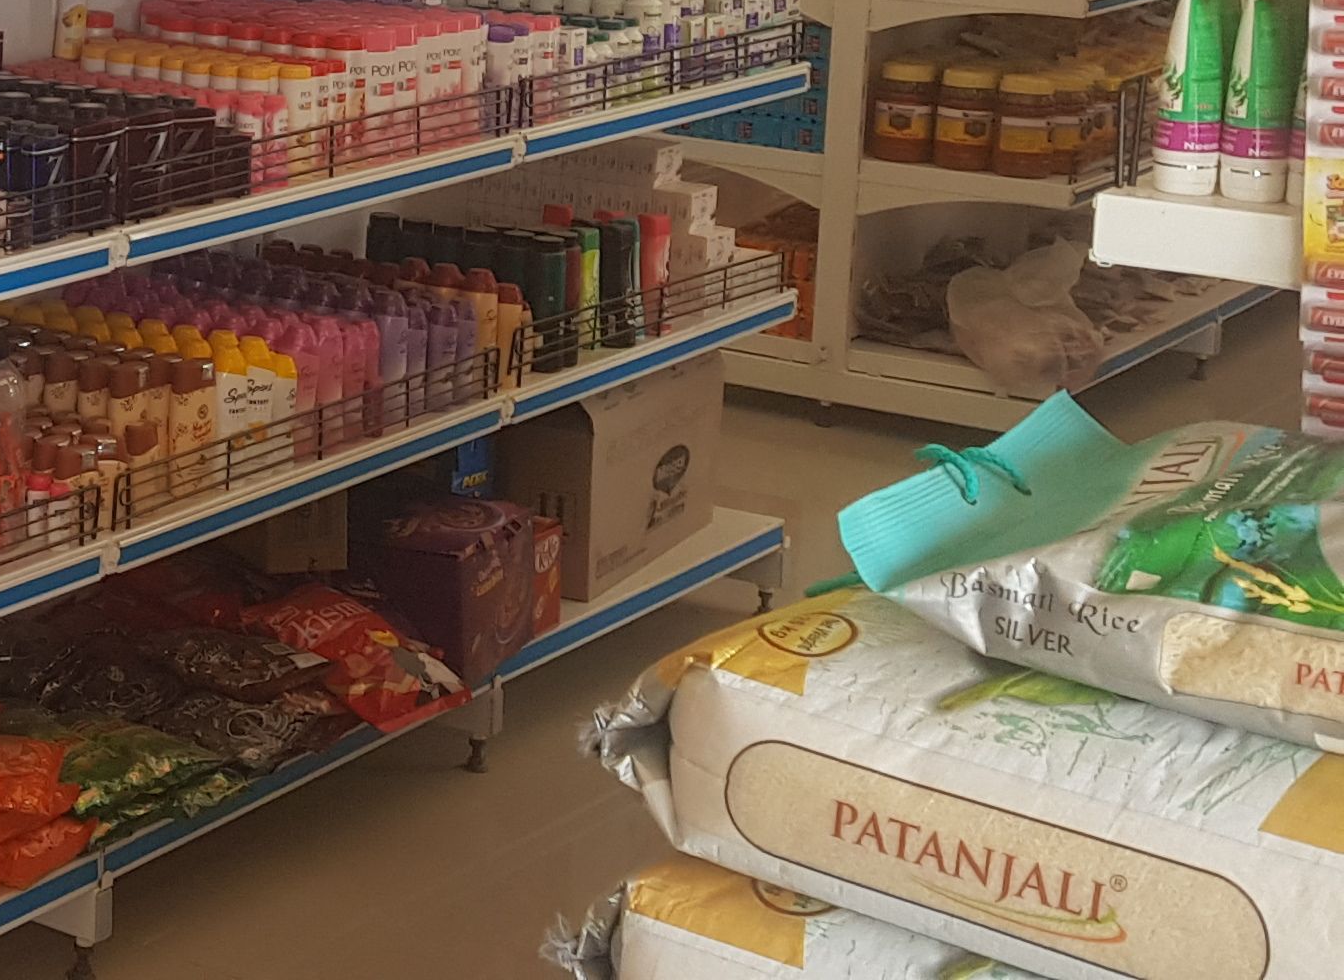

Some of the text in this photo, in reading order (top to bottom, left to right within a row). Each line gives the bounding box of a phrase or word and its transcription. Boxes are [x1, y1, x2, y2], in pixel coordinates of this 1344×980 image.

[995, 616, 1073, 655] SILVER
[1069, 603, 1141, 637] Rice
[830, 799, 1108, 922] PATANJALI
